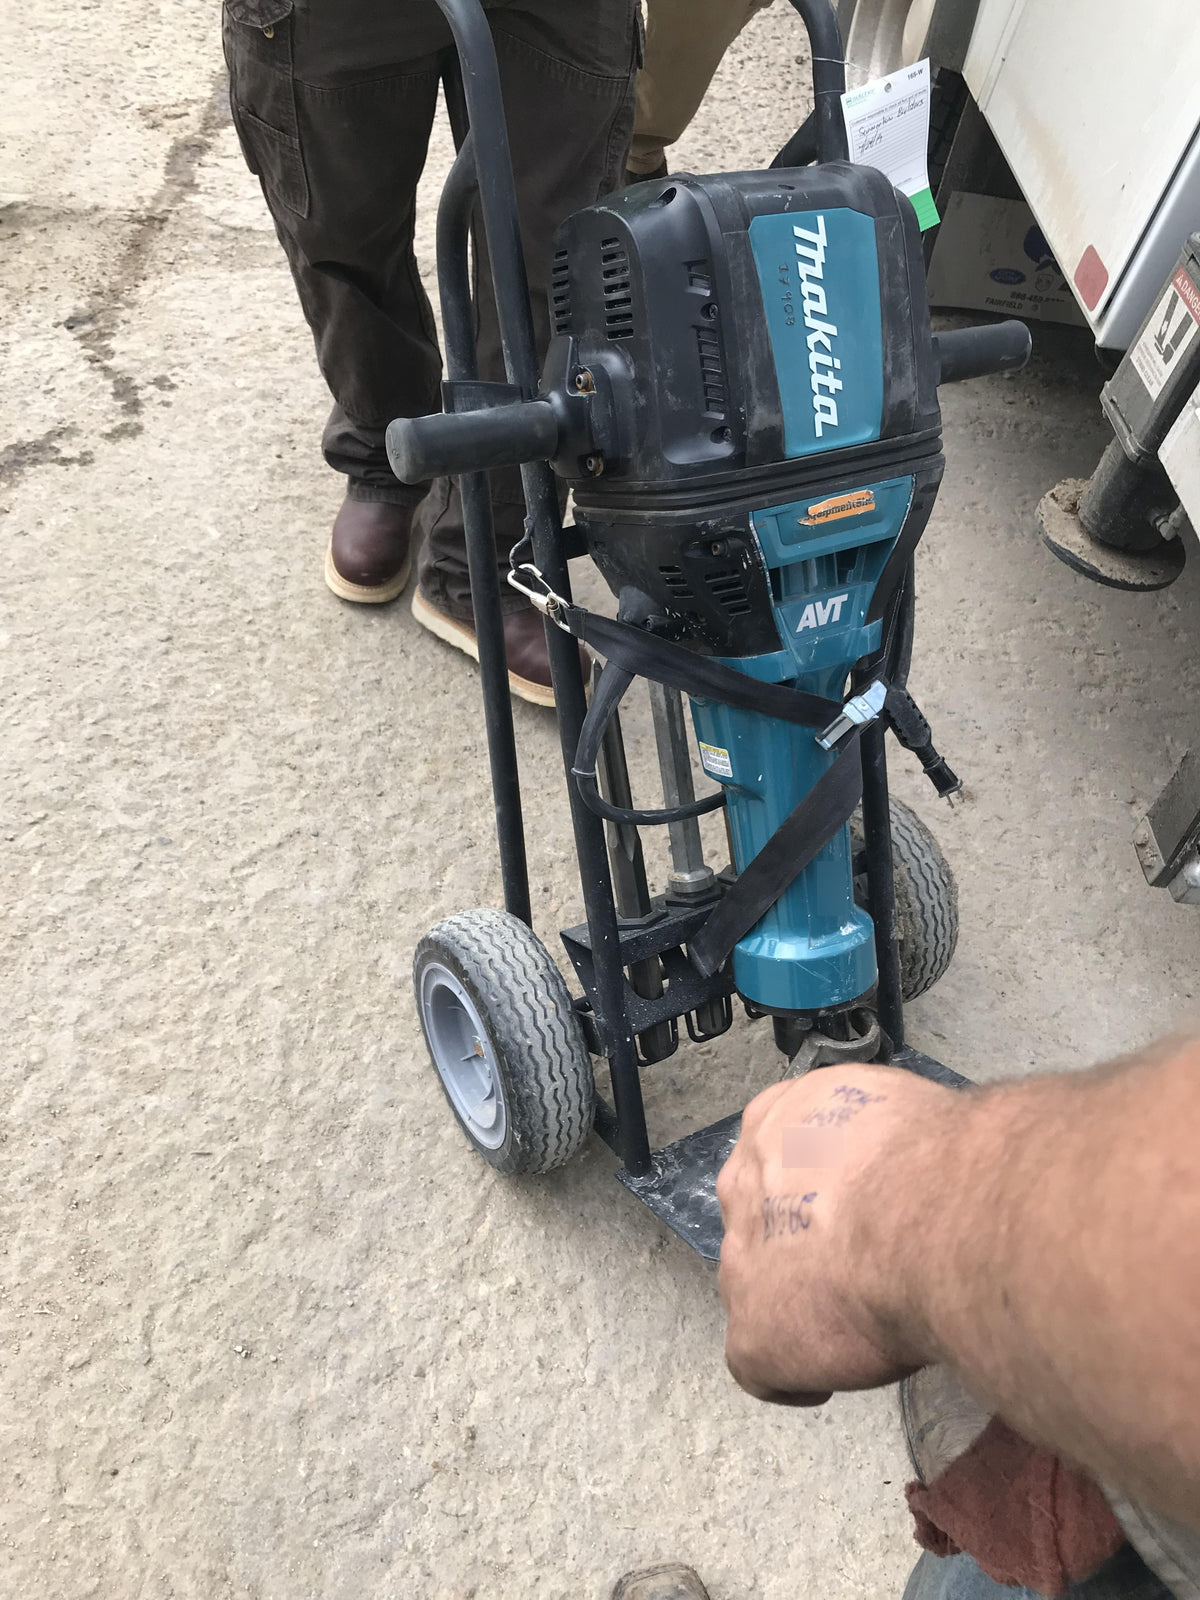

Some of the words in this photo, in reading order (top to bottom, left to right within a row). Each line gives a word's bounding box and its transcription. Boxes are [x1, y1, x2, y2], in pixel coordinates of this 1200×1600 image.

[984, 297, 1023, 310] FAIRFIELD
[1180, 278, 1200, 320] DANGE
[796, 594, 849, 633] AVT
